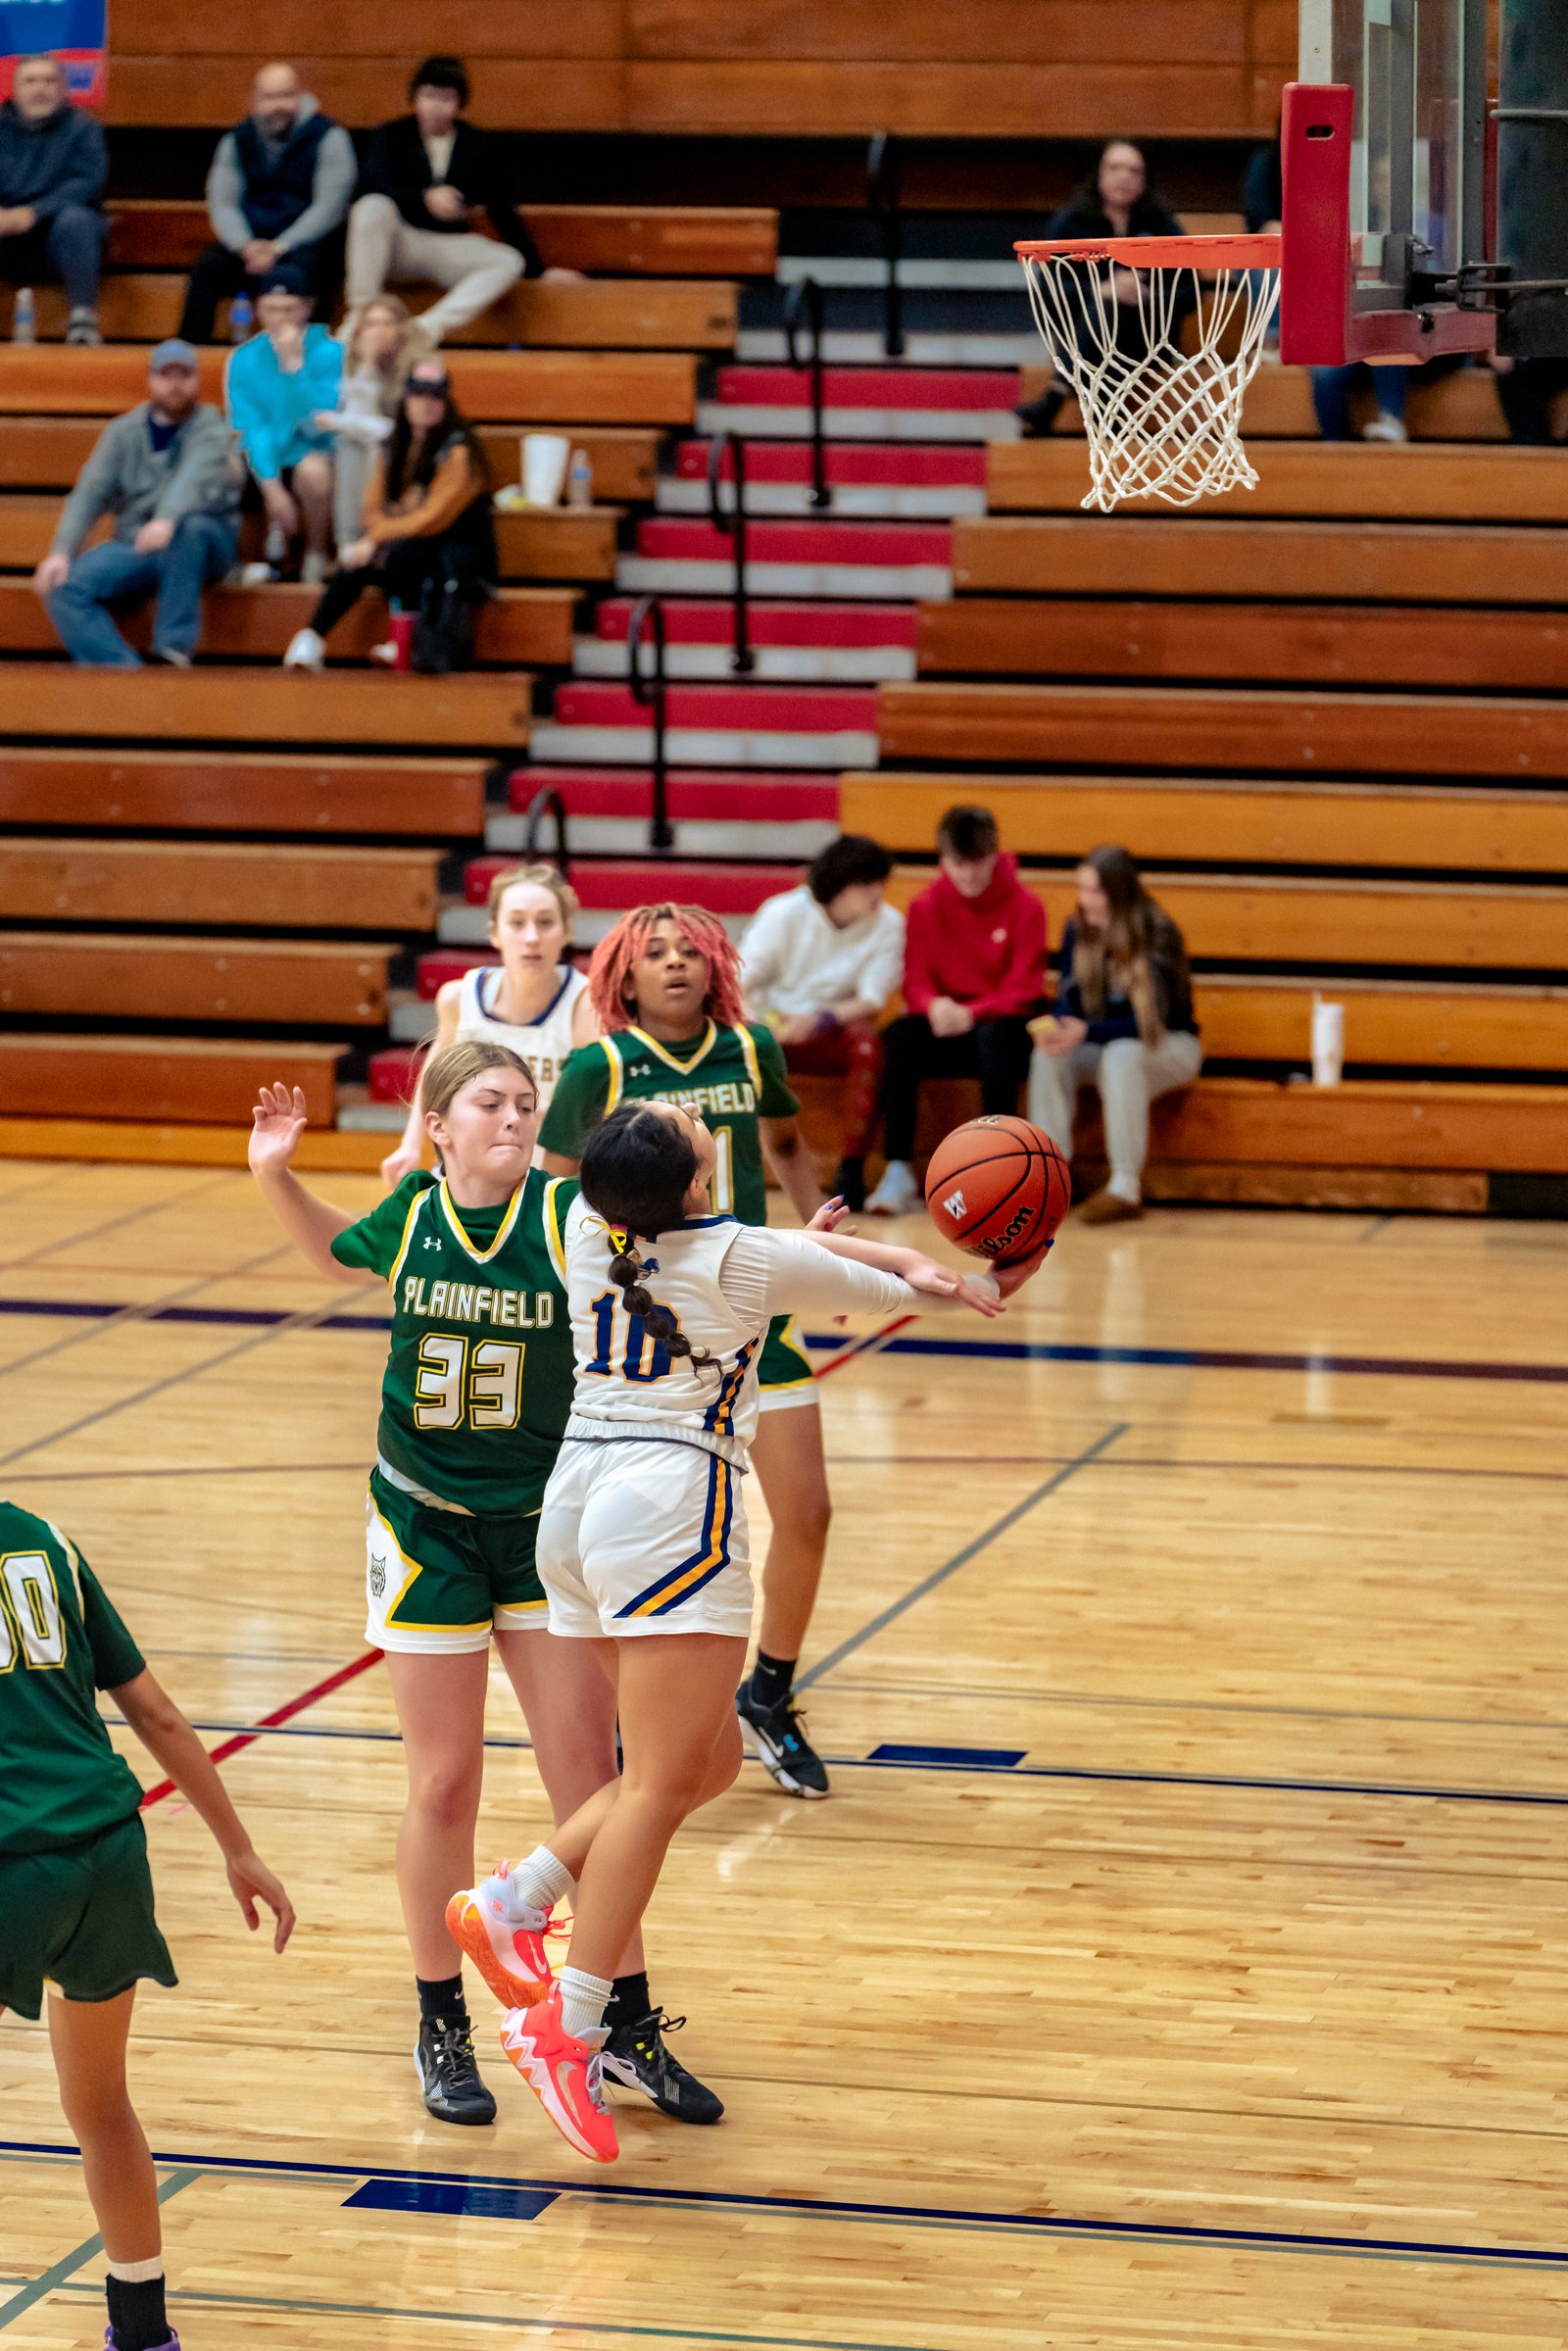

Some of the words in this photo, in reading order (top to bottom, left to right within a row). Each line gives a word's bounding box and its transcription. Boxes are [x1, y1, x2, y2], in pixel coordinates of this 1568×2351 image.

[712, 1125, 734, 1215] 1
[403, 1276, 554, 1329] PLAINFIELD
[583, 1289, 681, 1385] 10
[414, 1332, 526, 1430] 33
